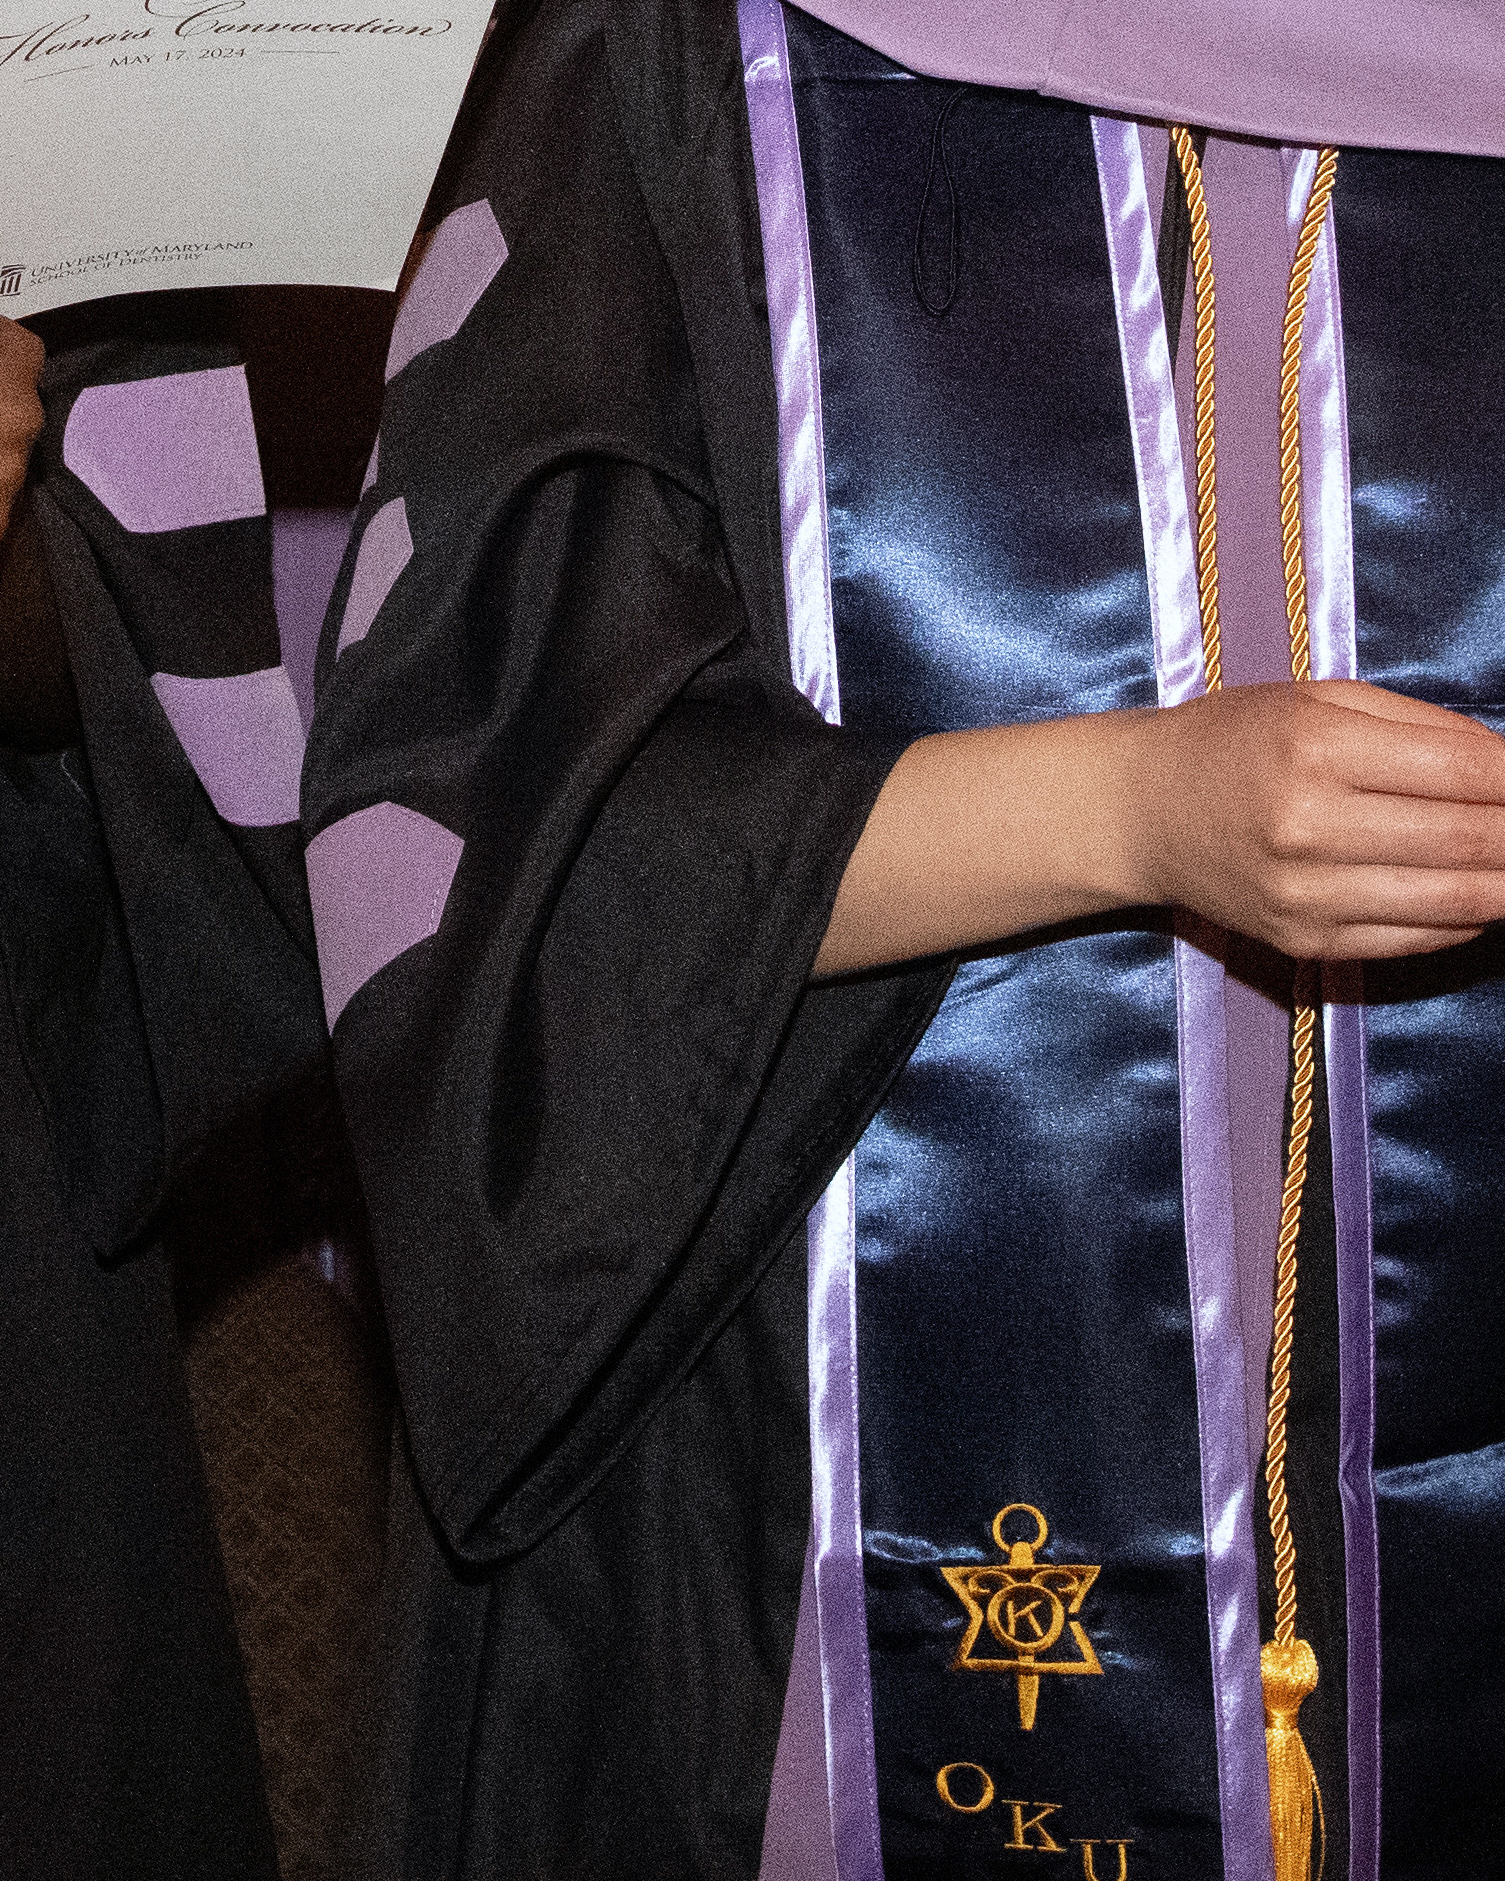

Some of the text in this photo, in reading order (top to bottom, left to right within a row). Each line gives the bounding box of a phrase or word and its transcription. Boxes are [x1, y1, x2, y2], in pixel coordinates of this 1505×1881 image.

[109, 53, 156, 69] MAY
[198, 46, 246, 60] 2024
[29, 253, 203, 286] SCHOOL OF DENTISTRY
[31, 249, 135, 278] UNIVERSITY
[151, 241, 254, 254] MARYLAND
